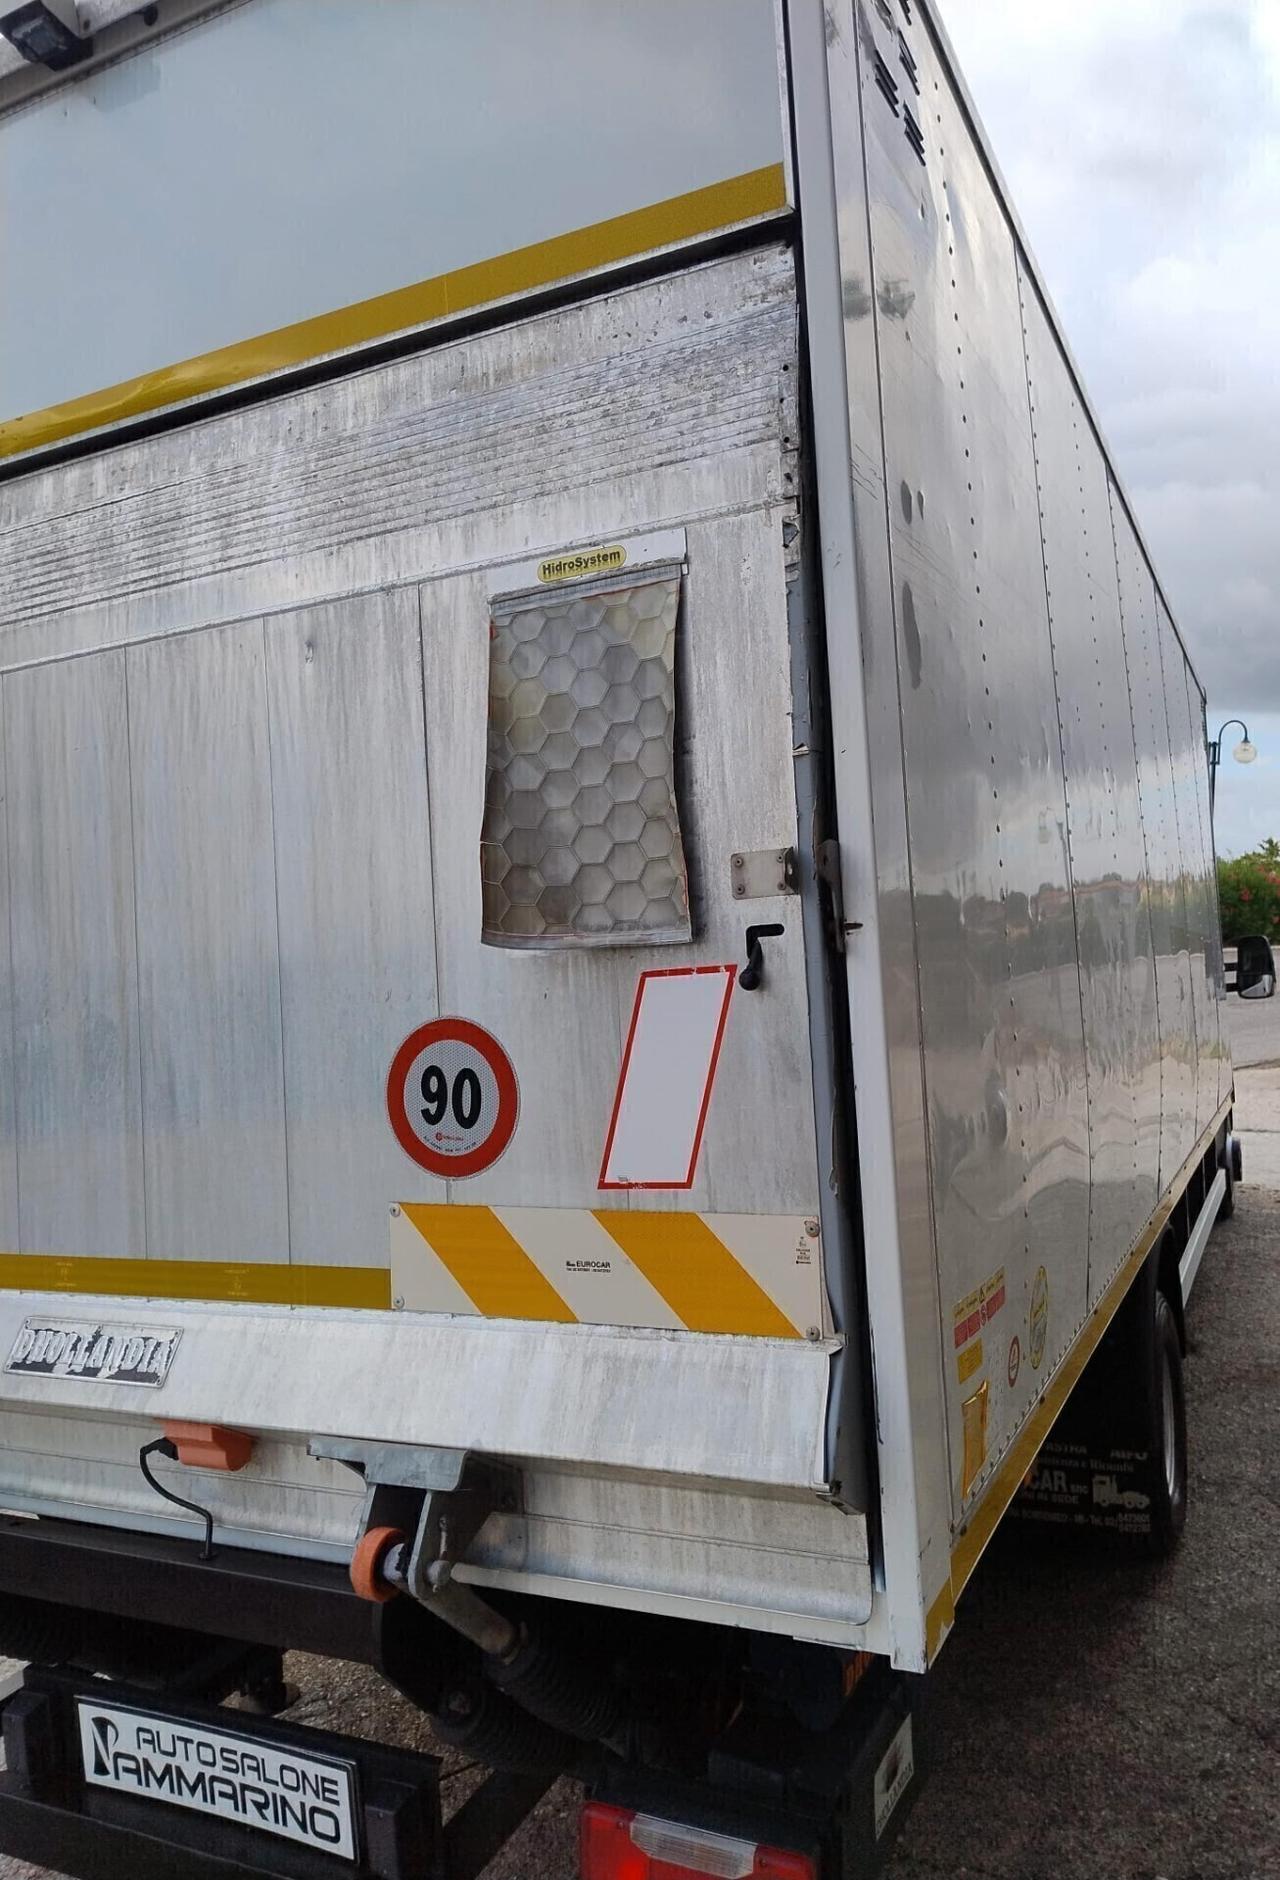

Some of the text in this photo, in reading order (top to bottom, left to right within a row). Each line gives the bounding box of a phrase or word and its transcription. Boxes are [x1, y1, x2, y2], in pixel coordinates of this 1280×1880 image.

[542, 550, 620, 575] HidroSystem
[421, 1065, 482, 1129] 90
[576, 1260, 611, 1269] EUROCAR
[136, 1726, 340, 1806] AUTOSALONE
